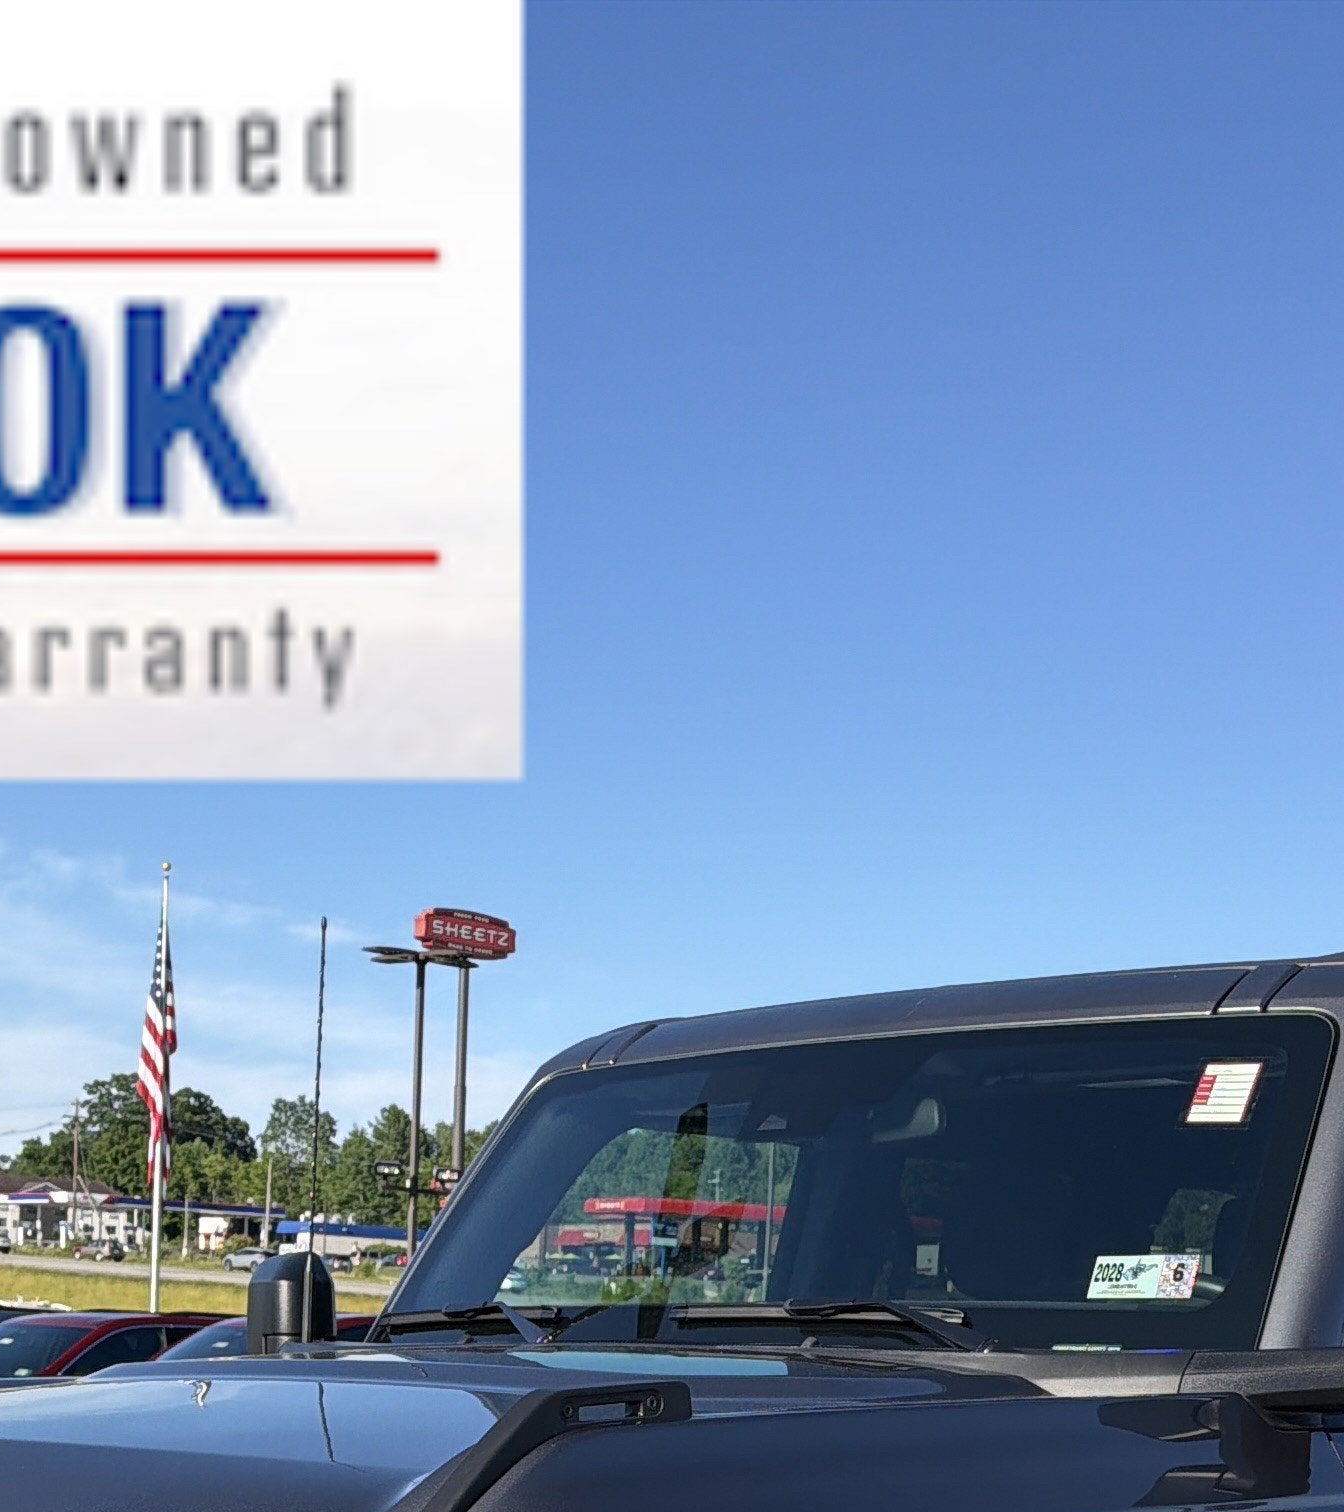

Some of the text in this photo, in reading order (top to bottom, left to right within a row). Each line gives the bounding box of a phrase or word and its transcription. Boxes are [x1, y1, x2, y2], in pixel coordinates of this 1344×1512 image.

[432, 919, 509, 947] SHEETZ
[1093, 1262, 1125, 1283] 2028
[1172, 1262, 1185, 1282] 6
